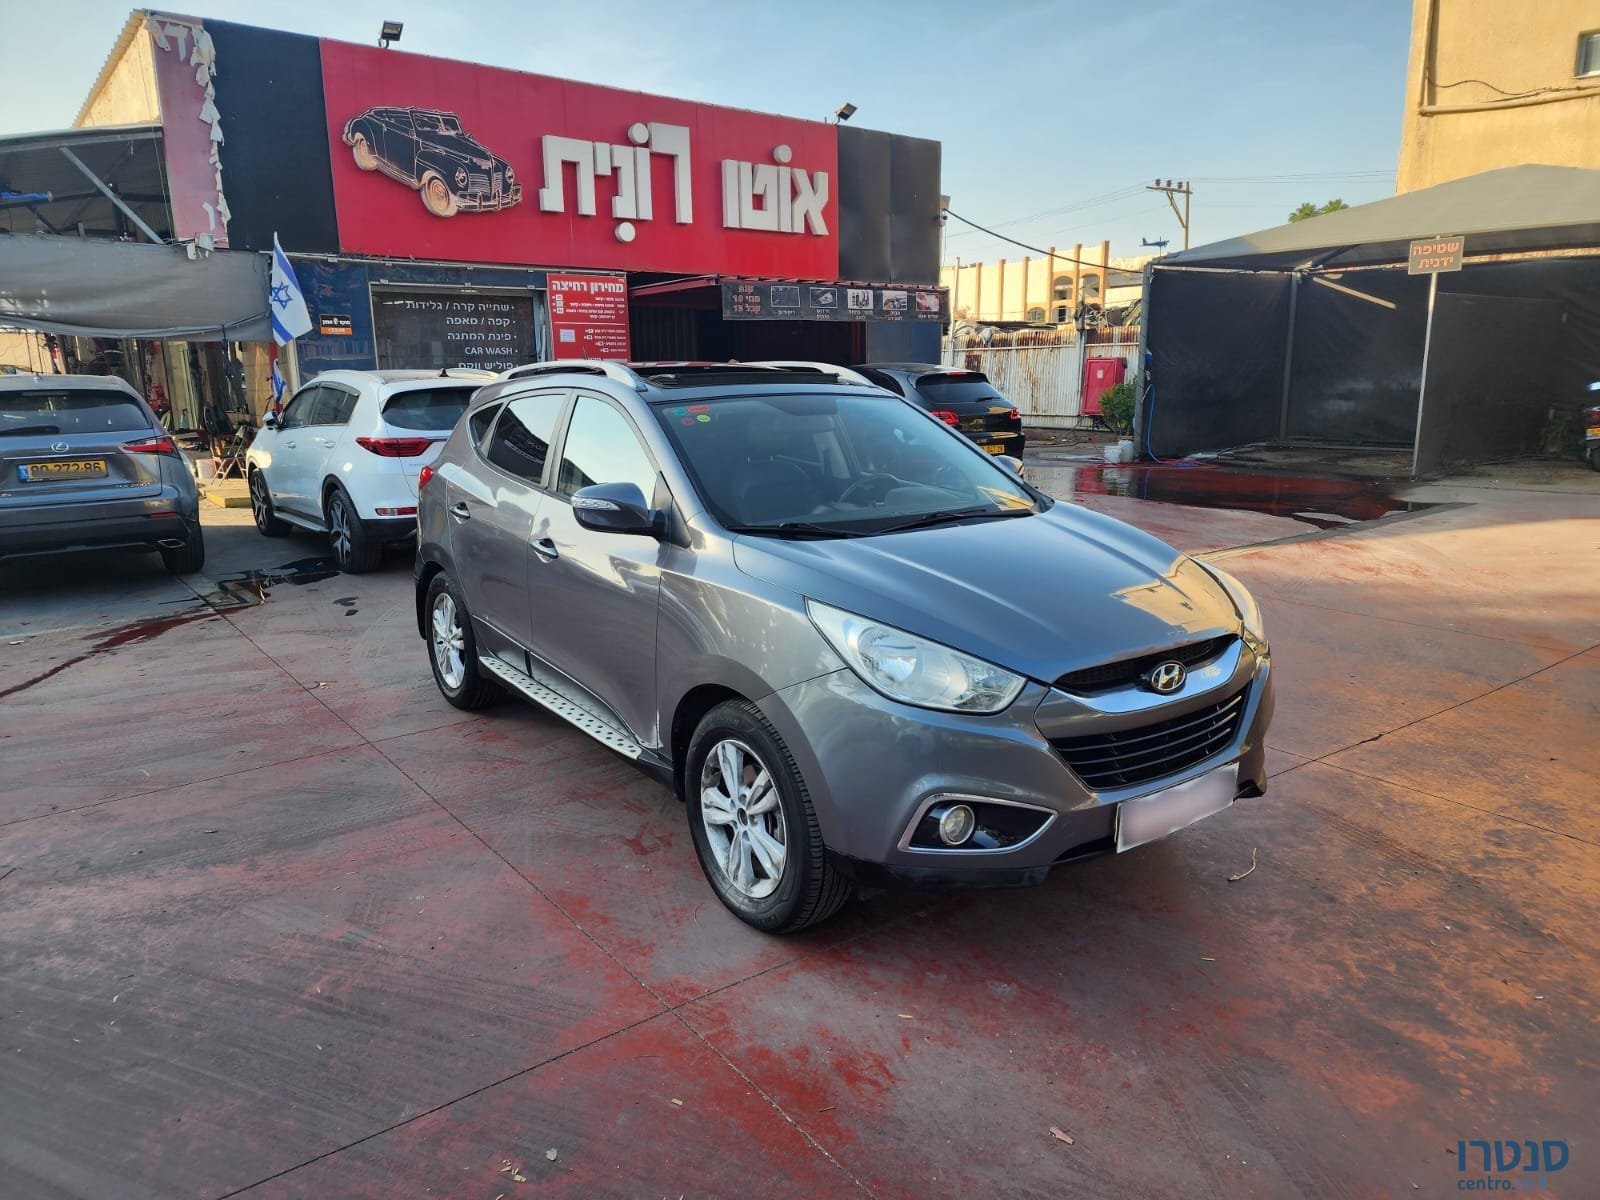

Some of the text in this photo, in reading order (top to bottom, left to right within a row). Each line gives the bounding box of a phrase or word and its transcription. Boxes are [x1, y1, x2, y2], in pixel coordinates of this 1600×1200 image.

[1412, 241, 1460, 256] שטיפה
[1418, 255, 1454, 269] ידנית
[551, 280, 624, 295] מחירון רחיצה
[405, 300, 443, 310] גלידות
[453, 302, 475, 312] קרה
[478, 302, 510, 312] שתייה
[446, 316, 478, 325] מאפה
[488, 318, 511, 327] קפה
[447, 332, 512, 341] פינת המתנה
[464, 346, 513, 355] CAR WASH
[484, 360, 514, 370] פוליש
